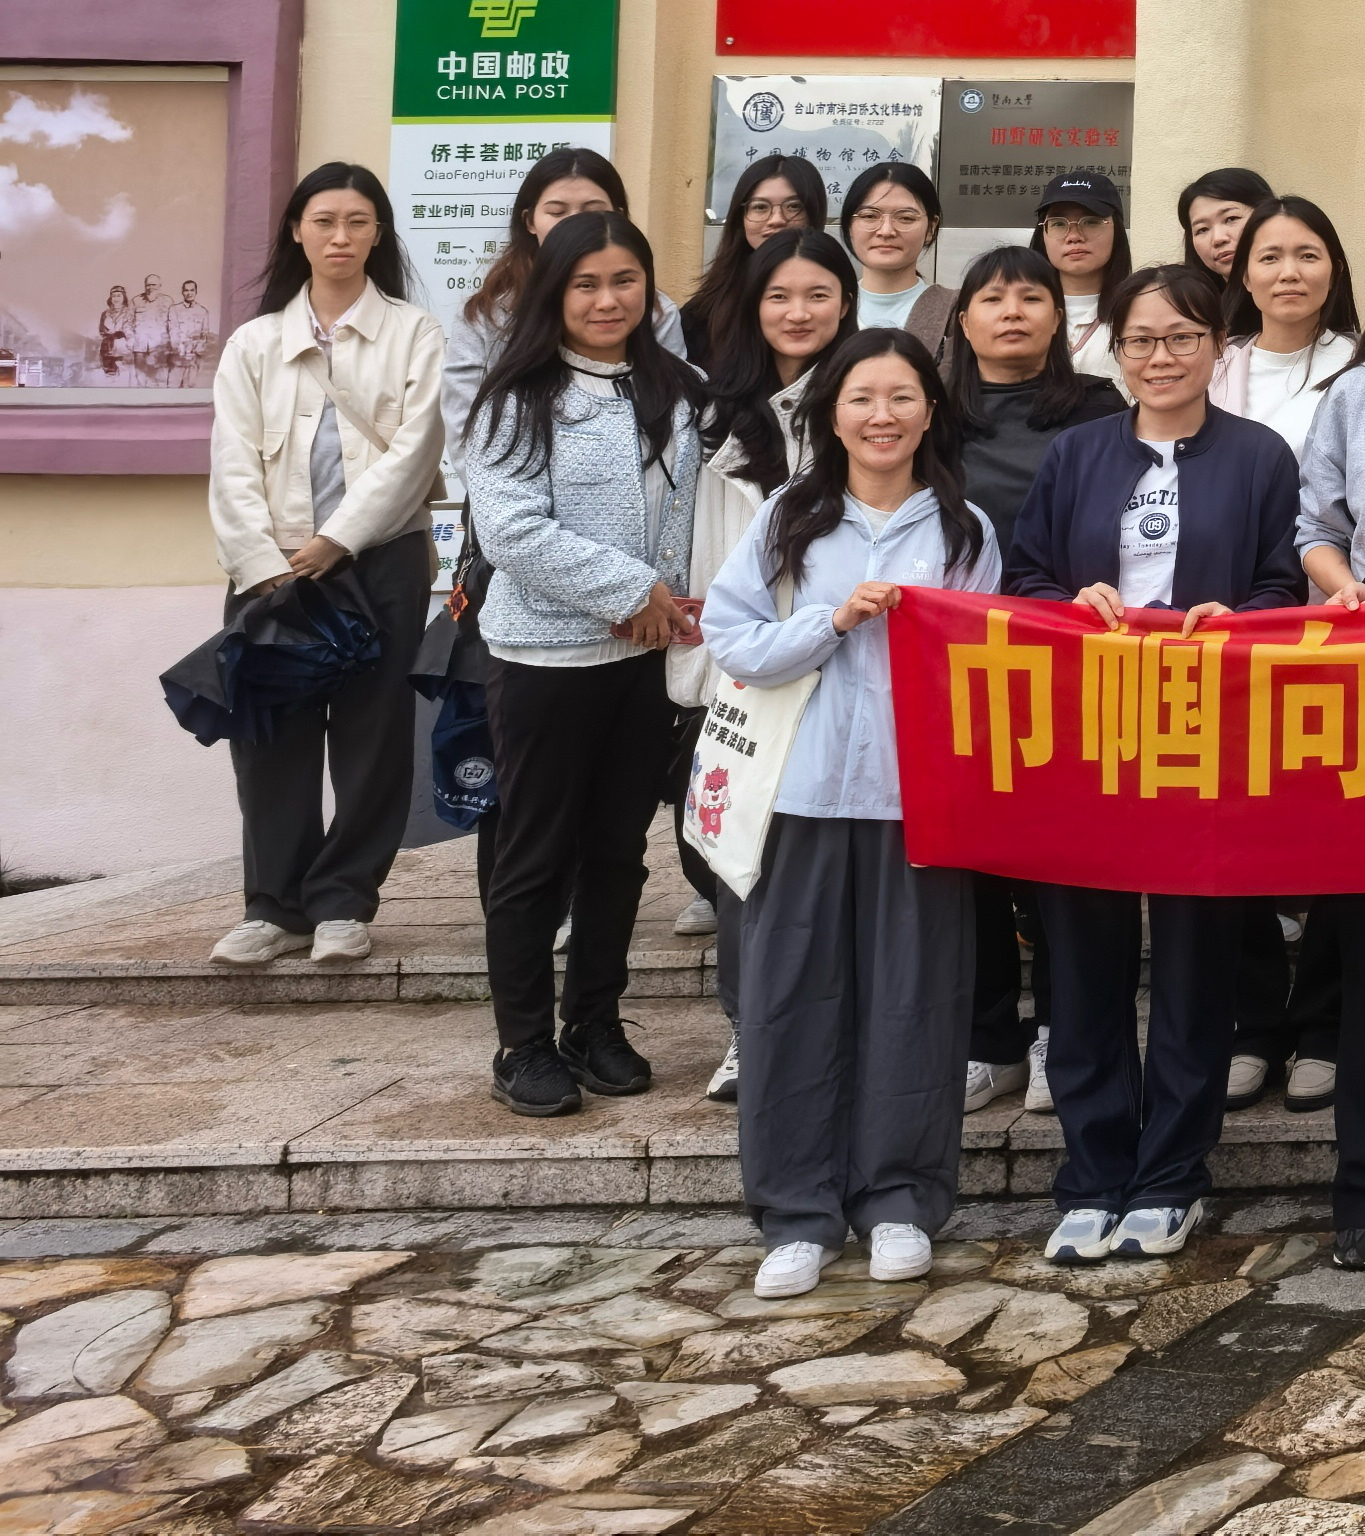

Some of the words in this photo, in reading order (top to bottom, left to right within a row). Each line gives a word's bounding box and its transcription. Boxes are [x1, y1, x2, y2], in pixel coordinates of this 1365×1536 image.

[437, 50, 571, 81] 中国邮政
[437, 85, 506, 100] CHINA
[515, 84, 570, 99] POST
[991, 127, 1120, 147] 田野研究实验室
[424, 169, 507, 181] QiaoFengHui
[412, 204, 475, 219] 营业时间
